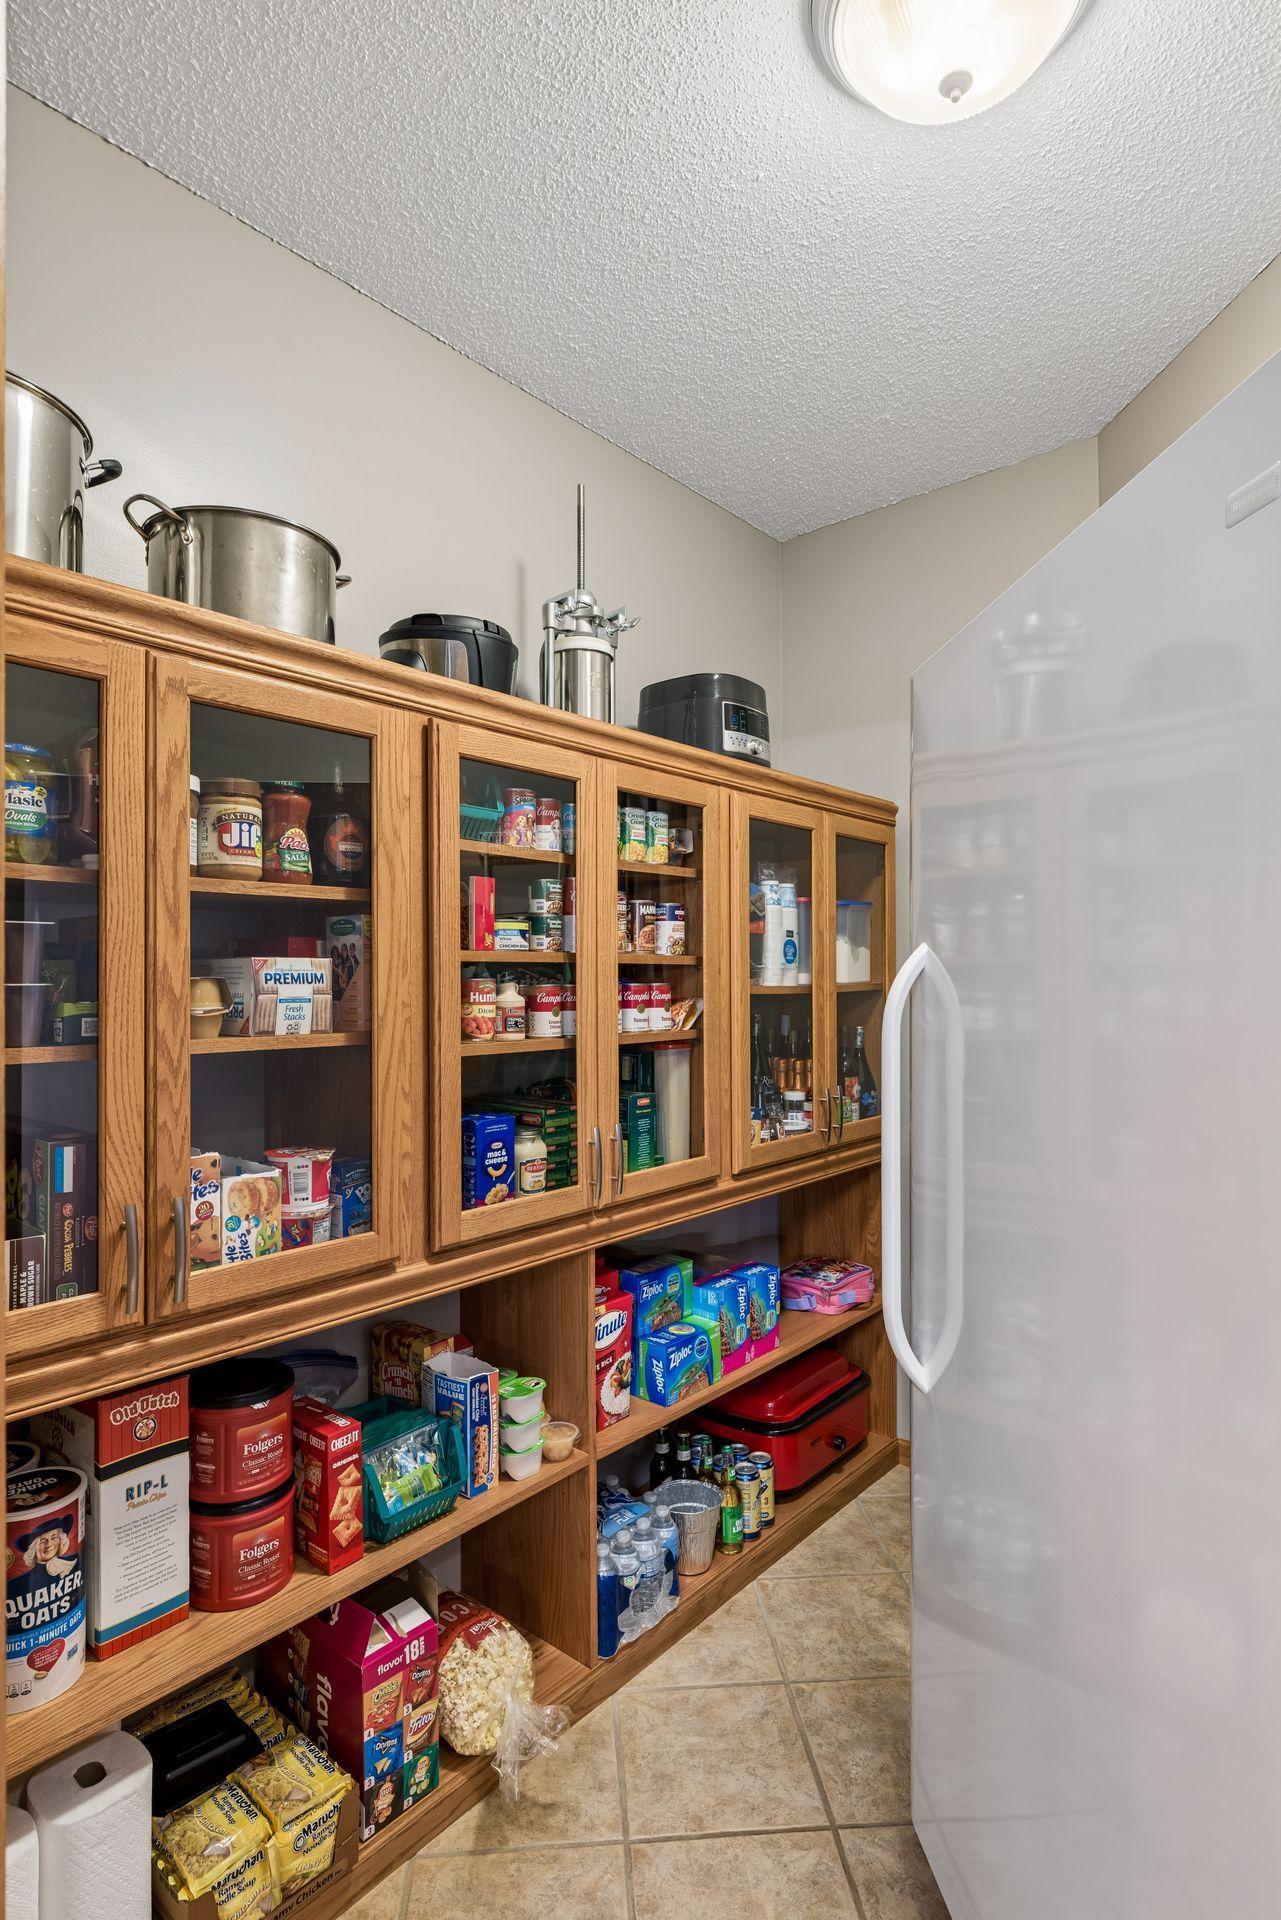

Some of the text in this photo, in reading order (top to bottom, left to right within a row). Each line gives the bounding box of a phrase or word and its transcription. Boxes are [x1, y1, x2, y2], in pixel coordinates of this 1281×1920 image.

[5, 793, 42, 807] lasic
[5, 809, 37, 823] Ovals
[222, 822, 262, 848] Jif
[264, 972, 325, 985] PREMIUM
[283, 1012, 306, 1021] Stacks
[284, 1004, 304, 1013] Fresh
[486, 1151, 501, 1159] mac
[198, 1202, 210, 1213] 20
[19, 1270, 27, 1304] MAPLE &
[642, 1281, 664, 1300] Ziploc
[768, 1273, 777, 1306] Ziploc
[737, 1285, 746, 1320] Ziploc
[594, 1310, 627, 1343] inute
[600, 1355, 613, 1368] RICE
[669, 1344, 693, 1370] Ziploc
[381, 1362, 413, 1380] Crunch
[651, 1358, 666, 1394] Ziploc
[384, 1381, 413, 1400] Munch
[437, 1378, 465, 1394] TASTIEST
[437, 1386, 465, 1401] VALUE
[110, 1391, 180, 1425] Old Dutch
[243, 1433, 283, 1456] Folgers
[330, 1429, 359, 1452] CHEEZ-IT
[242, 1456, 267, 1468] Classic
[332, 1453, 359, 1469] ORIGINAL
[125, 1473, 168, 1503] RIP-L
[239, 1537, 279, 1561] Folgers
[238, 1560, 264, 1575] Classic
[6, 1570, 82, 1618] QUAKER
[21, 1595, 71, 1629] OATS
[6, 1610, 82, 1652] UICK 1-MINUTE OATS
[377, 1654, 404, 1676] flavor
[404, 1640, 420, 1665] 18
[411, 1668, 432, 1681] Doritos
[409, 1709, 435, 1736] Fritos
[375, 1737, 398, 1751] Doritos
[303, 1739, 337, 1777] Maruchan
[302, 1761, 316, 1778] Soup
[224, 1783, 259, 1822] Maruchan
[224, 1811, 236, 1825] Soup
[311, 1821, 336, 1842] Ramen
[302, 1833, 329, 1856] Noodle
[218, 1876, 245, 1899] Ramen
[236, 1877, 257, 1893] Soup
[295, 1873, 334, 1905] Chicken
